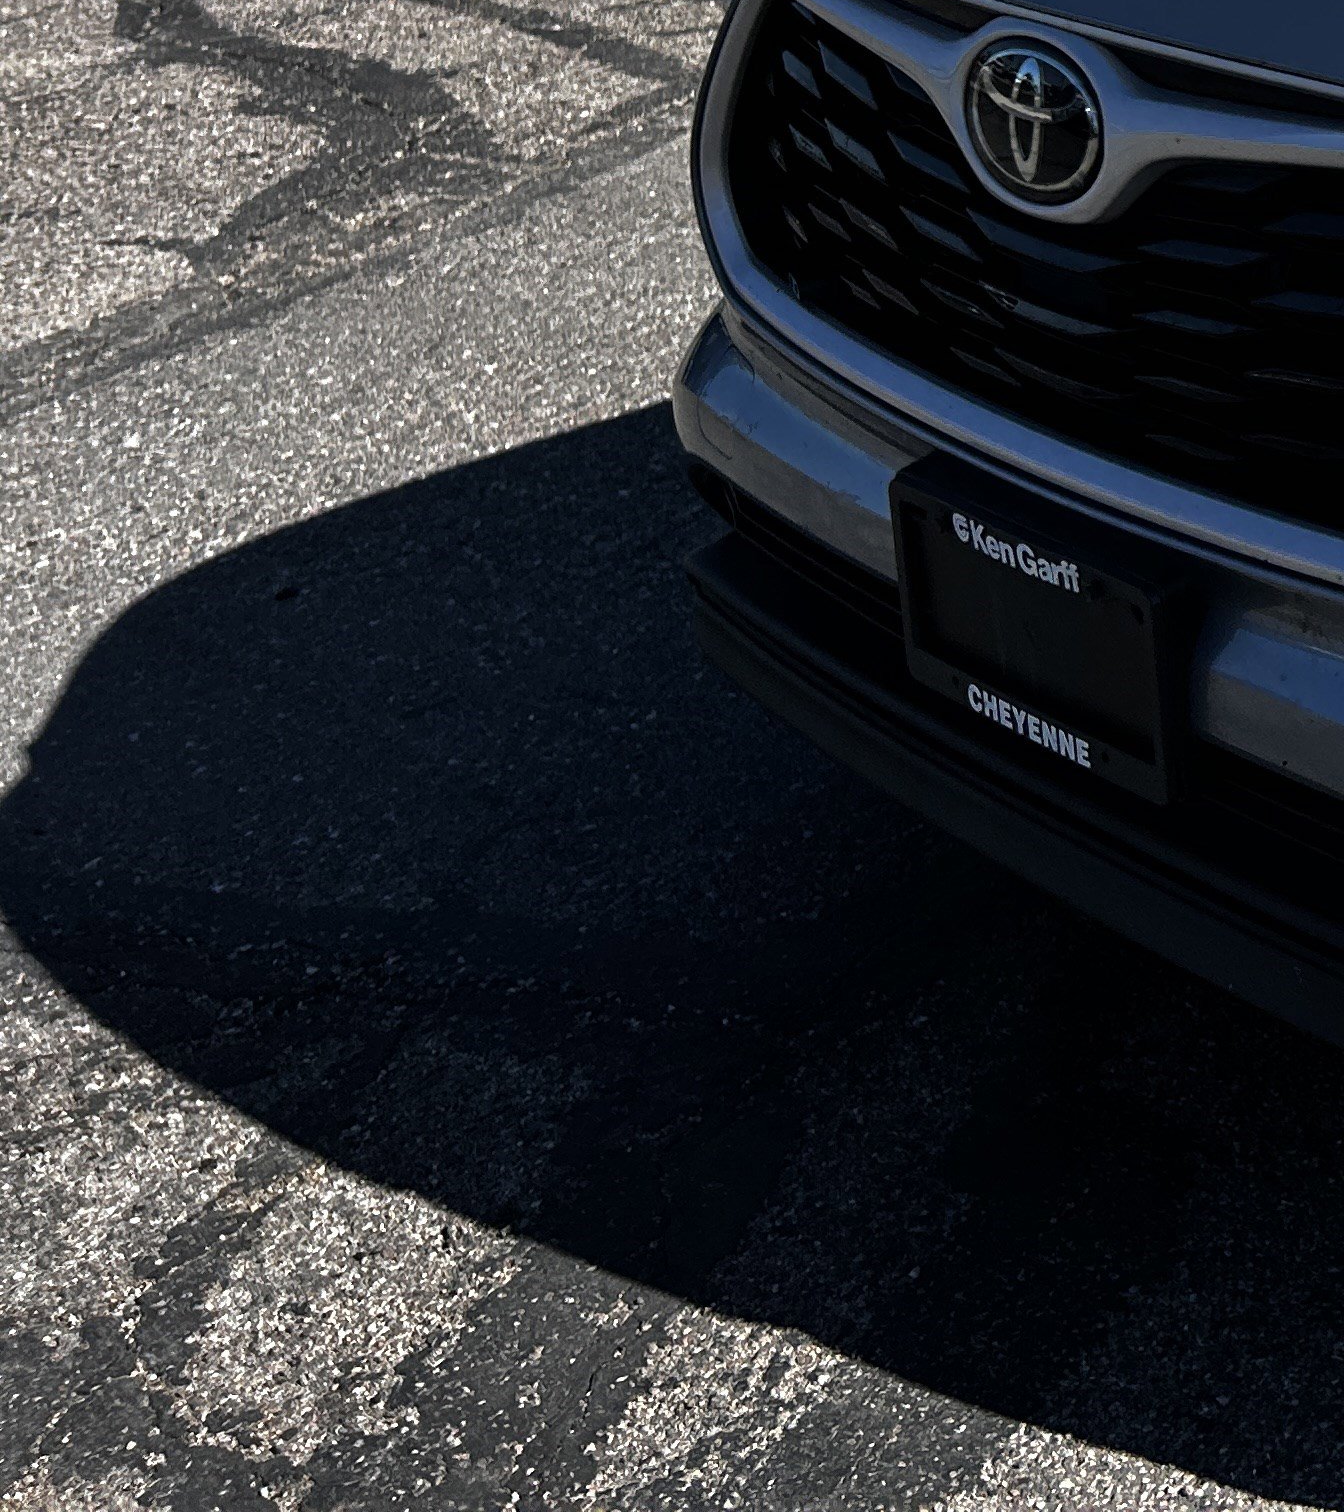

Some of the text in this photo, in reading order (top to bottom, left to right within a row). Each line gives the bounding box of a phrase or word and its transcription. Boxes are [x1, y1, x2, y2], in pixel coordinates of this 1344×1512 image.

[968, 519, 1081, 594] Ken Garff
[967, 683, 1092, 770] CHEYENNE
